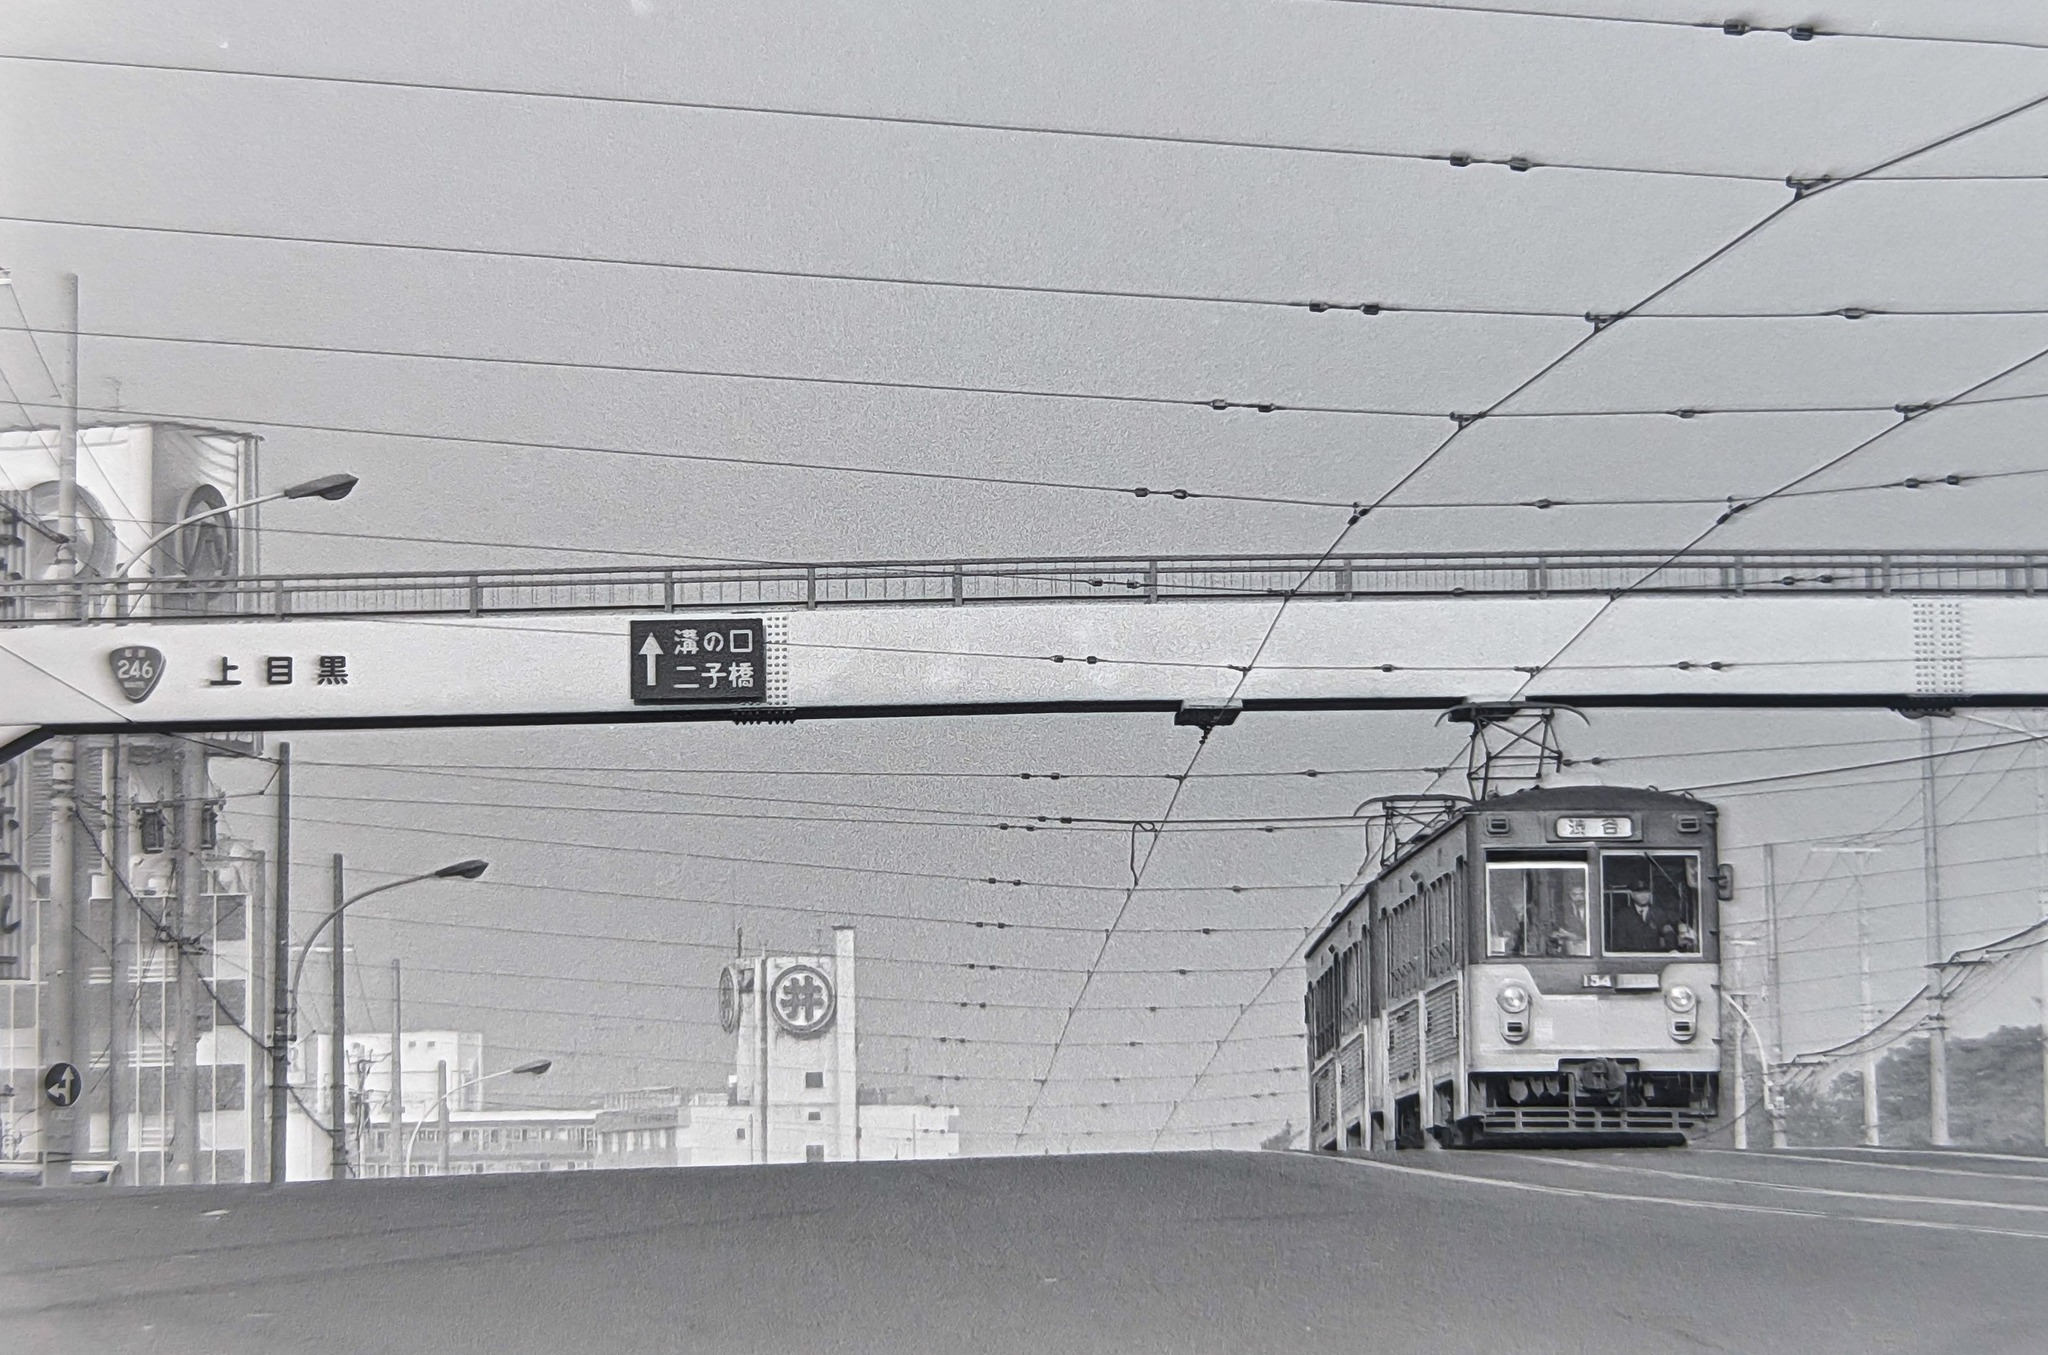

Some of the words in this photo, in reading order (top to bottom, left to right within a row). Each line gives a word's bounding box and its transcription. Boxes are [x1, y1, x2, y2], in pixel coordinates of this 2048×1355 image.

[674, 629, 753, 655] 溝の口
[118, 659, 153, 679] 246
[209, 655, 349, 686] 上目黒
[673, 661, 754, 689] 二子橋
